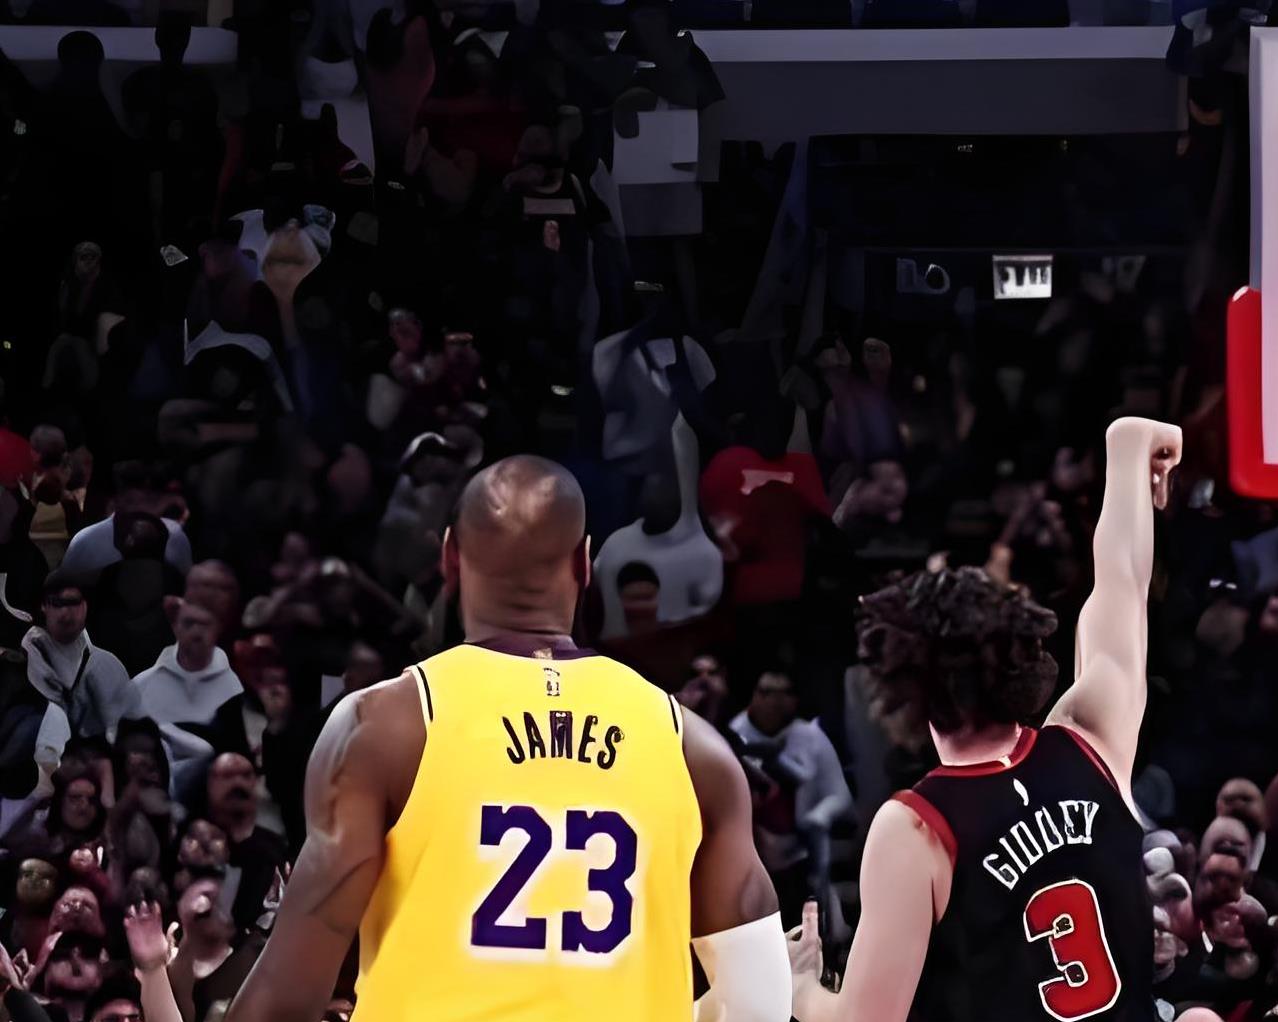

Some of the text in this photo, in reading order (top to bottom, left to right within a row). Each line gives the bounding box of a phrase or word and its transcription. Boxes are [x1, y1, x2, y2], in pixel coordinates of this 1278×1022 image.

[502, 711, 625, 770] JAMES
[471, 804, 638, 954] 23
[1023, 877, 1122, 1022] 3
